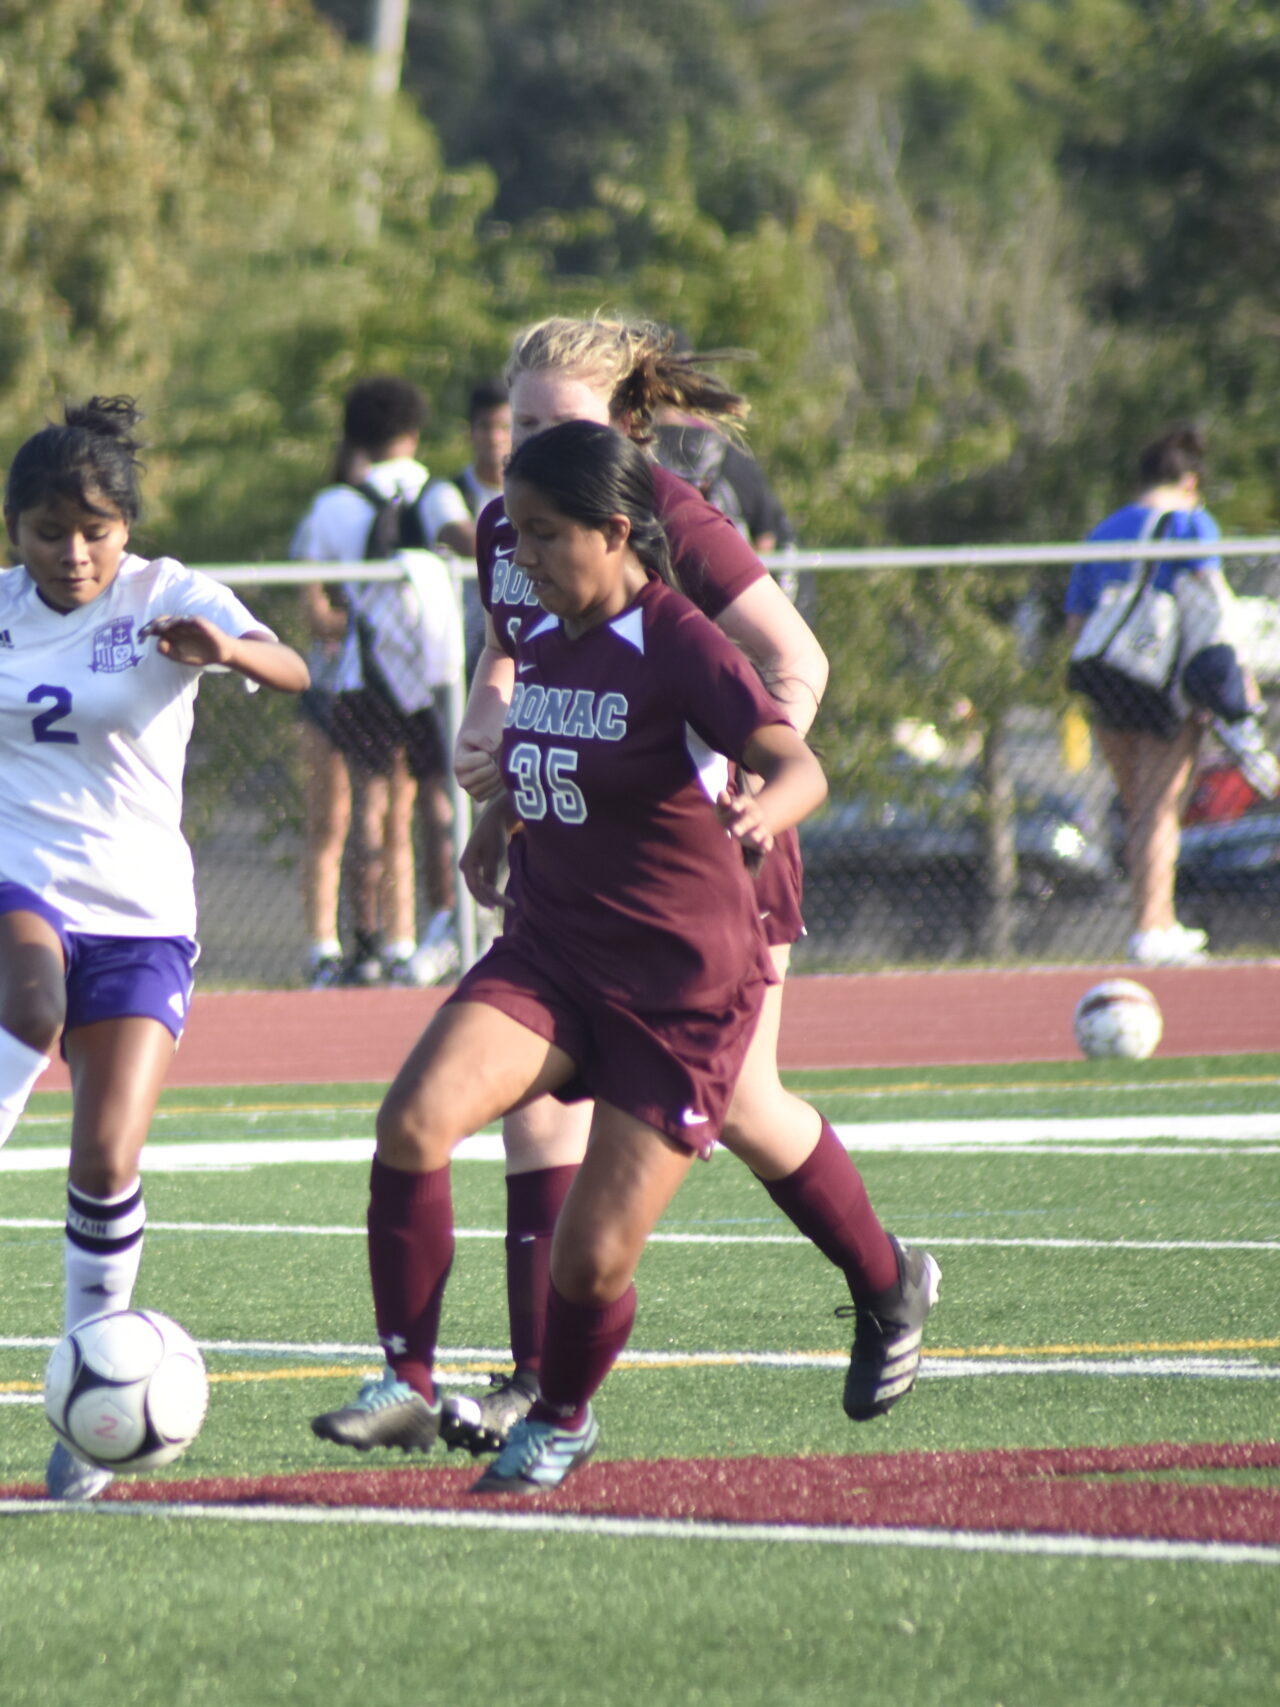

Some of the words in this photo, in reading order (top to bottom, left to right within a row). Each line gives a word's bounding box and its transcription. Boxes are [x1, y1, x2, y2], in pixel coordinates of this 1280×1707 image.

[27, 683, 79, 745] 2
[504, 682, 628, 741] BONAC
[509, 742, 588, 824] 35
[94, 1414, 119, 1440] 2
